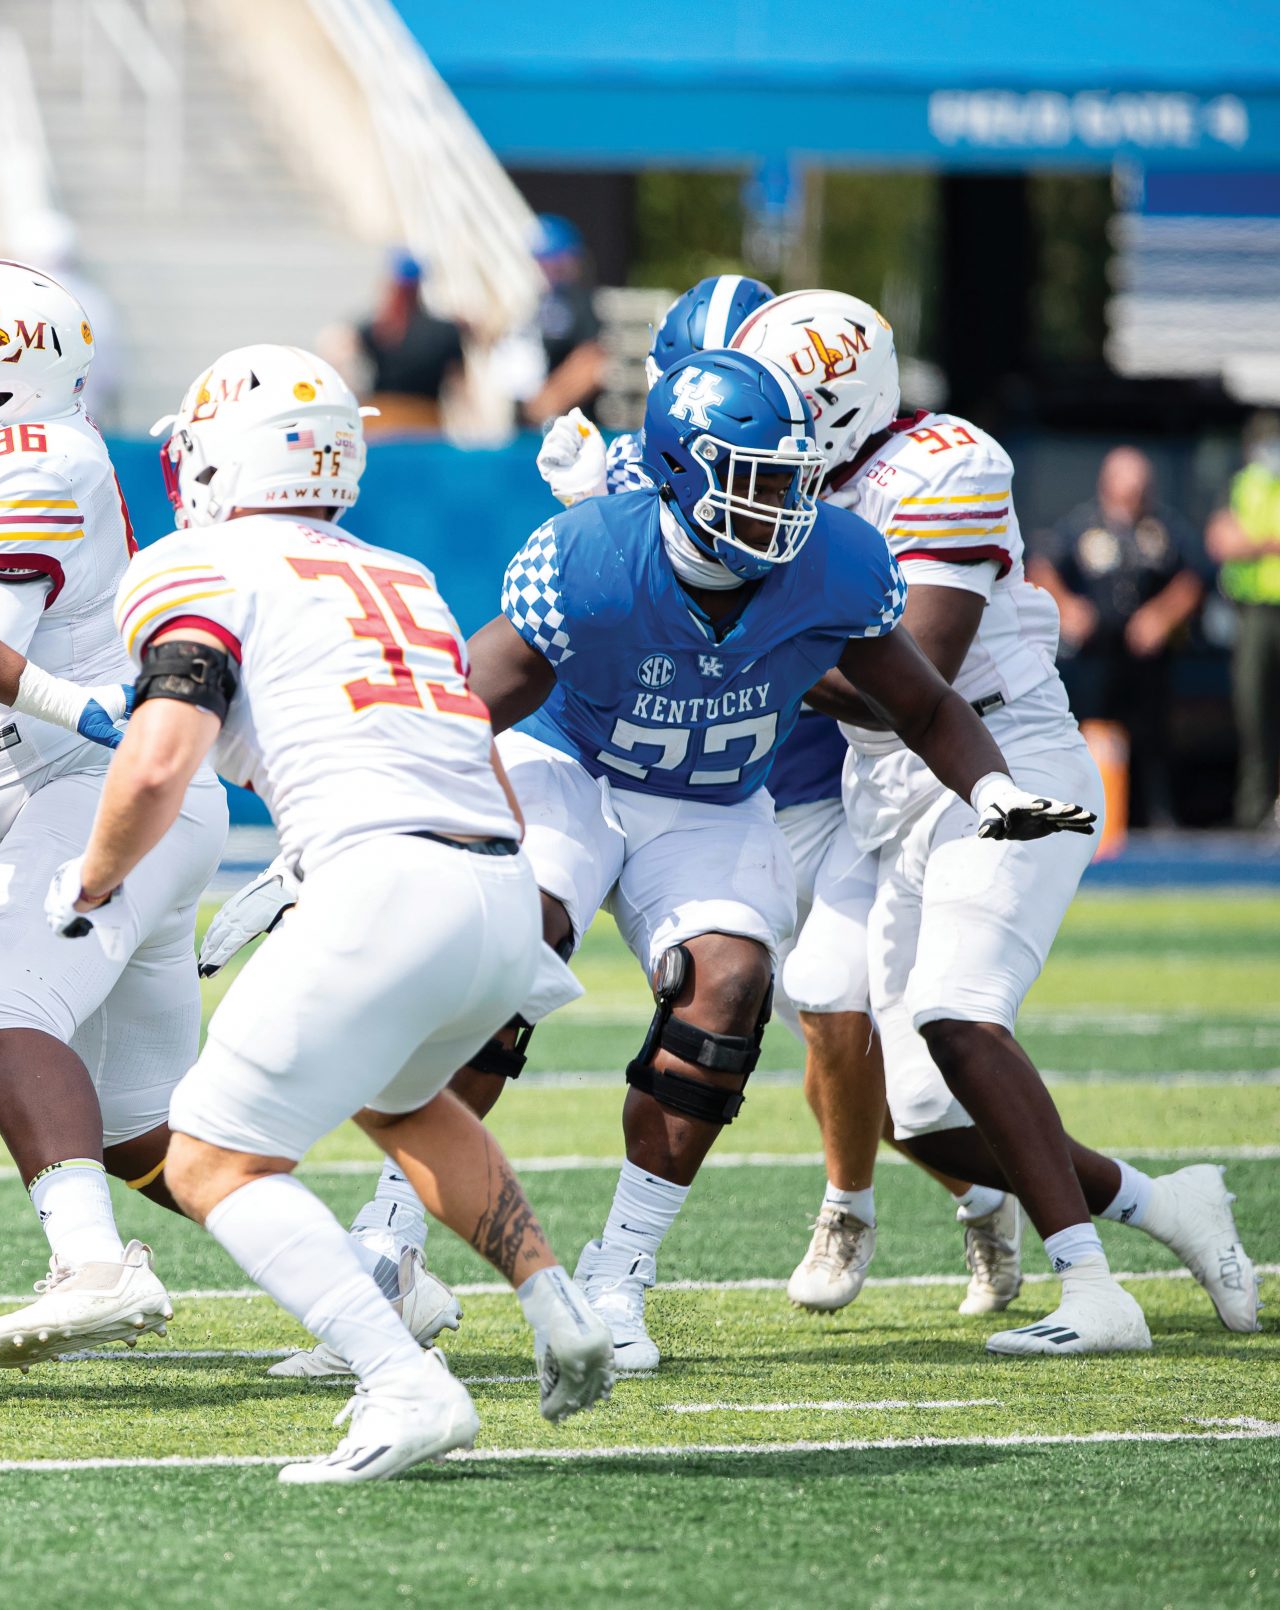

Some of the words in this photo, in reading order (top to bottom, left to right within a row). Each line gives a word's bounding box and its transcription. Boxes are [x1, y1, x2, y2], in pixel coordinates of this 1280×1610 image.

[786, 326, 872, 384] ULM
[190, 369, 245, 423] LM
[668, 365, 724, 430] UK
[905, 422, 979, 455] 93
[310, 450, 341, 477] 35
[867, 459, 897, 487] BC
[265, 488, 321, 501] HAWK
[283, 556, 492, 724] 35
[640, 656, 673, 687] SEC
[697, 654, 724, 678] UK
[631, 681, 771, 724] KENTUCKY
[595, 711, 779, 785] 77
